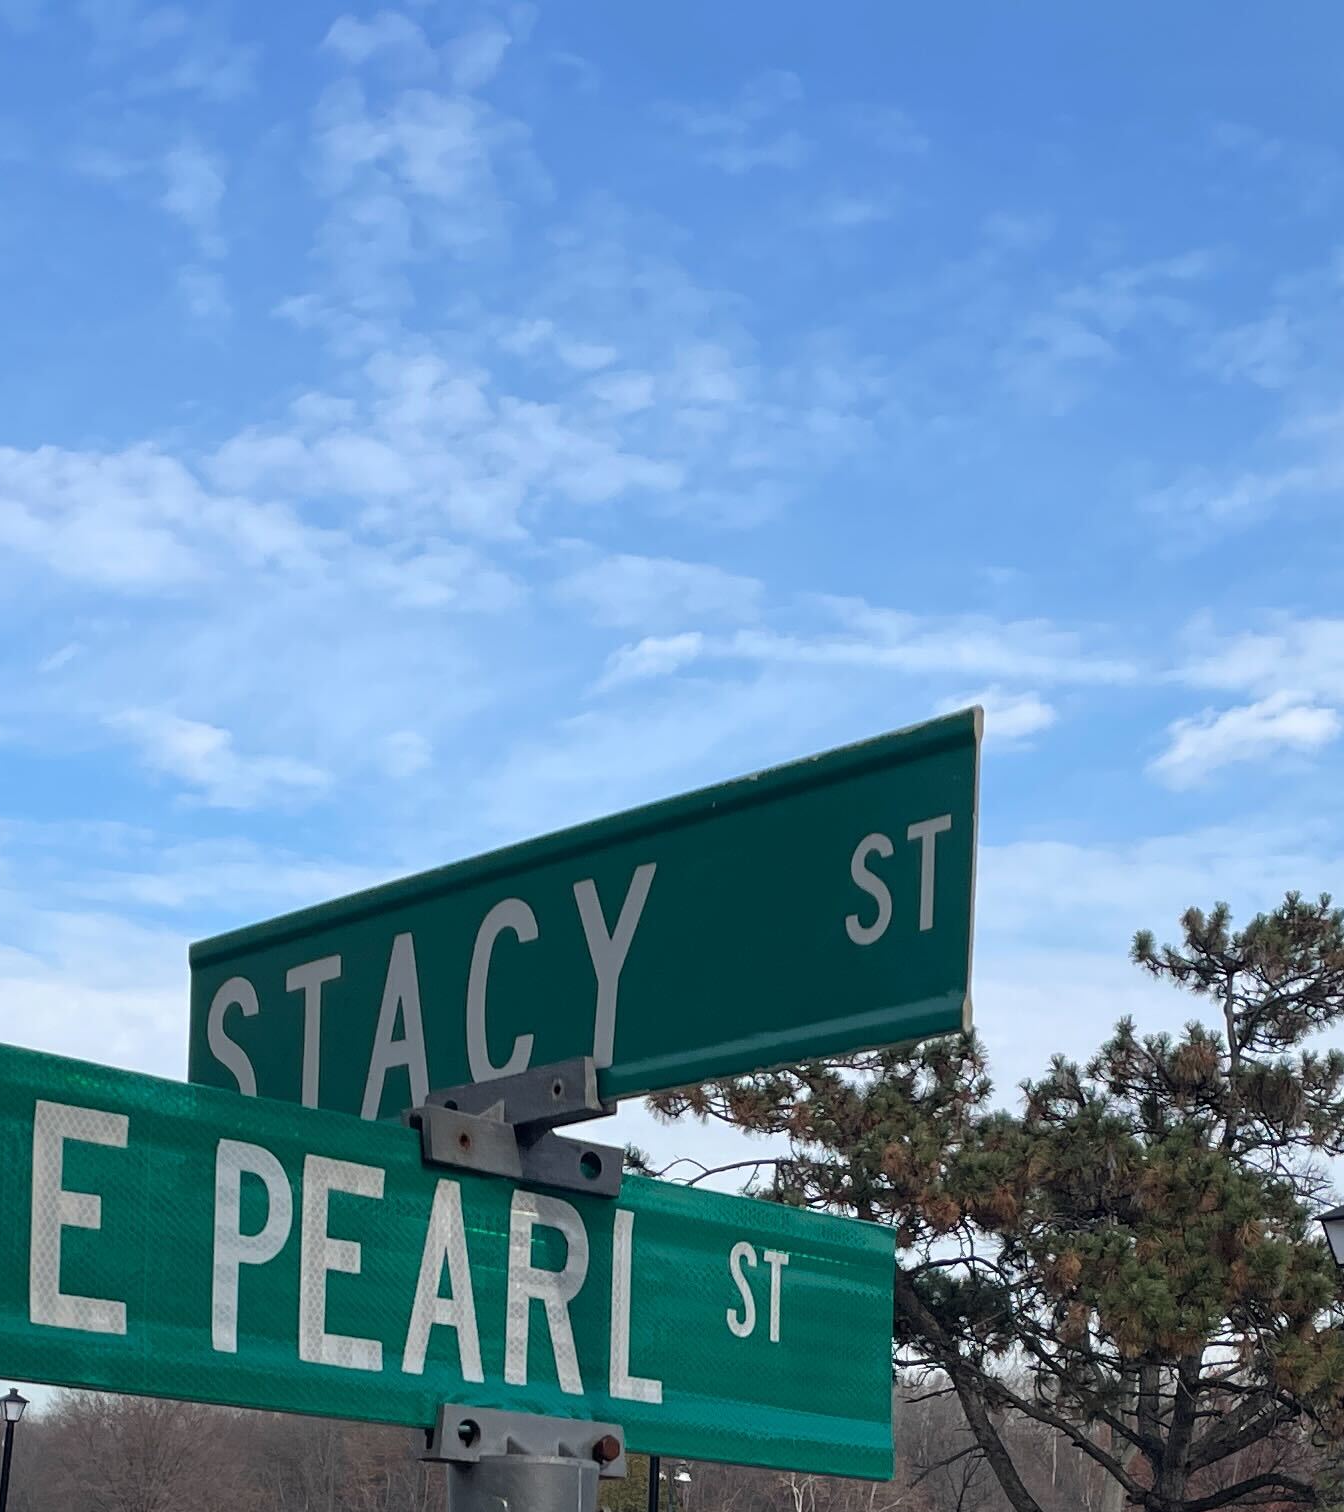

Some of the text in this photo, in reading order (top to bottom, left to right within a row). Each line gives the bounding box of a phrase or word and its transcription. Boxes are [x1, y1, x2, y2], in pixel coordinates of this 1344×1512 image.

[207, 813, 953, 1121] STACY ST
[29, 1098, 791, 1404] E PEARL ST
